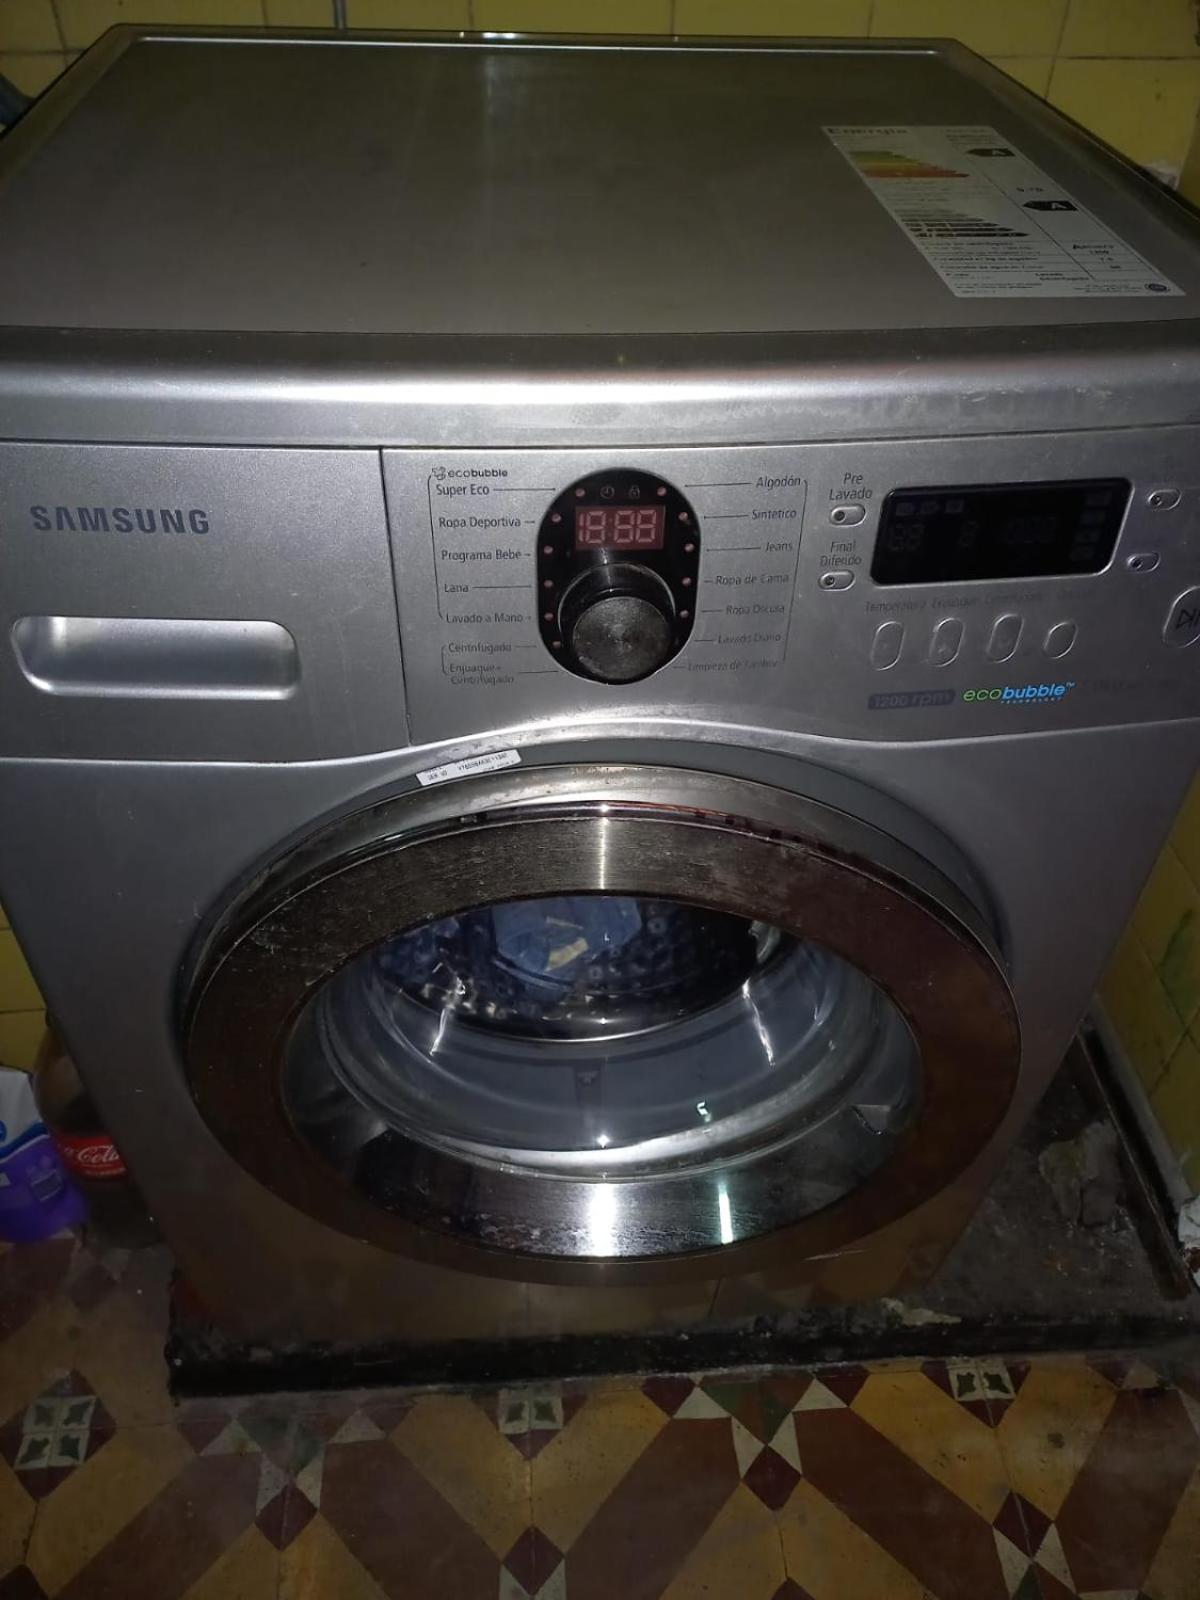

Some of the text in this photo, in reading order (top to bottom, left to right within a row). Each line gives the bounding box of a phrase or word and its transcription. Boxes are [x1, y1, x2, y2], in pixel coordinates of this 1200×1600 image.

[448, 468, 508, 478] ecobubble
[843, 472, 864, 485] Pre
[756, 475, 801, 491] Algodón
[436, 484, 490, 498] Super Eco
[829, 487, 873, 501] Lavado
[30, 506, 210, 535] SAMSUNG
[439, 516, 522, 530] Ropa Deportiva
[765, 542, 793, 553] Jeans
[830, 540, 857, 553] Final
[441, 549, 492, 564] Programa
[444, 583, 469, 593] Lana
[446, 613, 482, 624] Lavado
[494, 613, 523, 623] Mano
